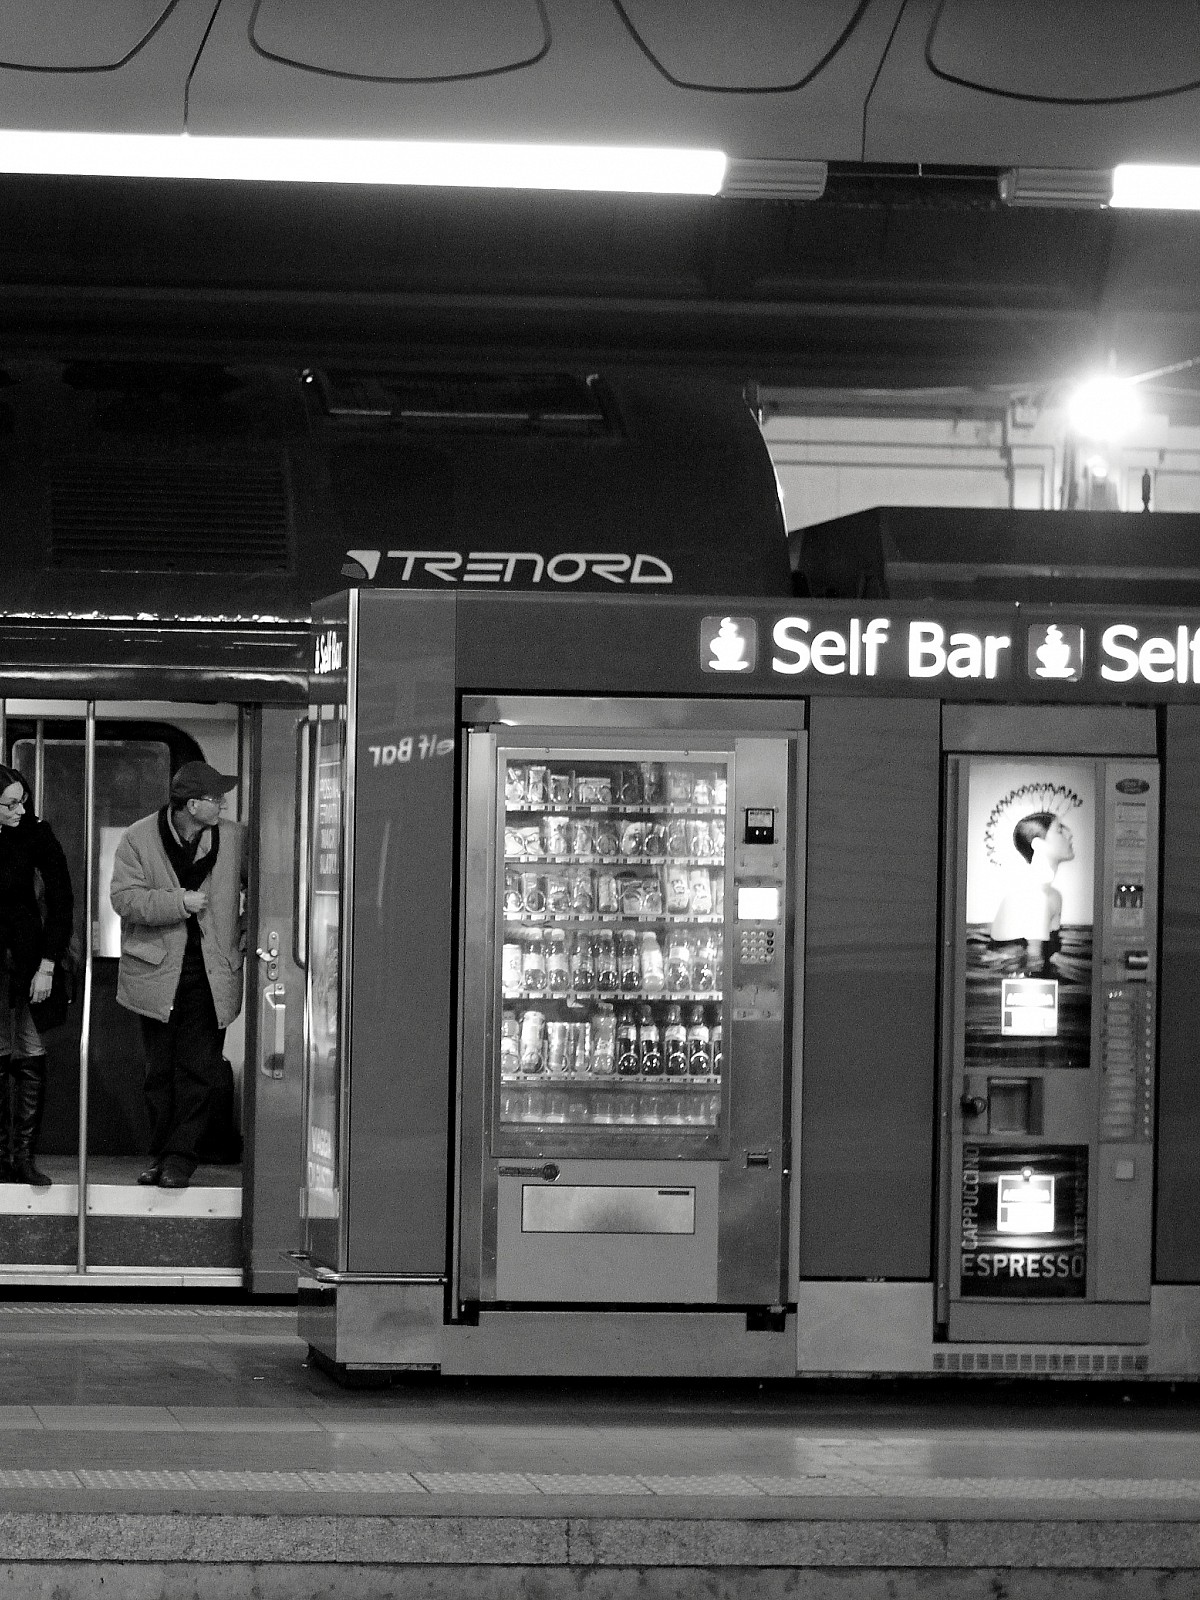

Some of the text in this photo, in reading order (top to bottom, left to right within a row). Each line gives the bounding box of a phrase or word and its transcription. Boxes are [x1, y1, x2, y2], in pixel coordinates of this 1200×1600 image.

[387, 550, 674, 584] TRENORD
[772, 616, 891, 677] Self
[908, 620, 1011, 679] Bar
[961, 1253, 1085, 1278] ESPRESSO
